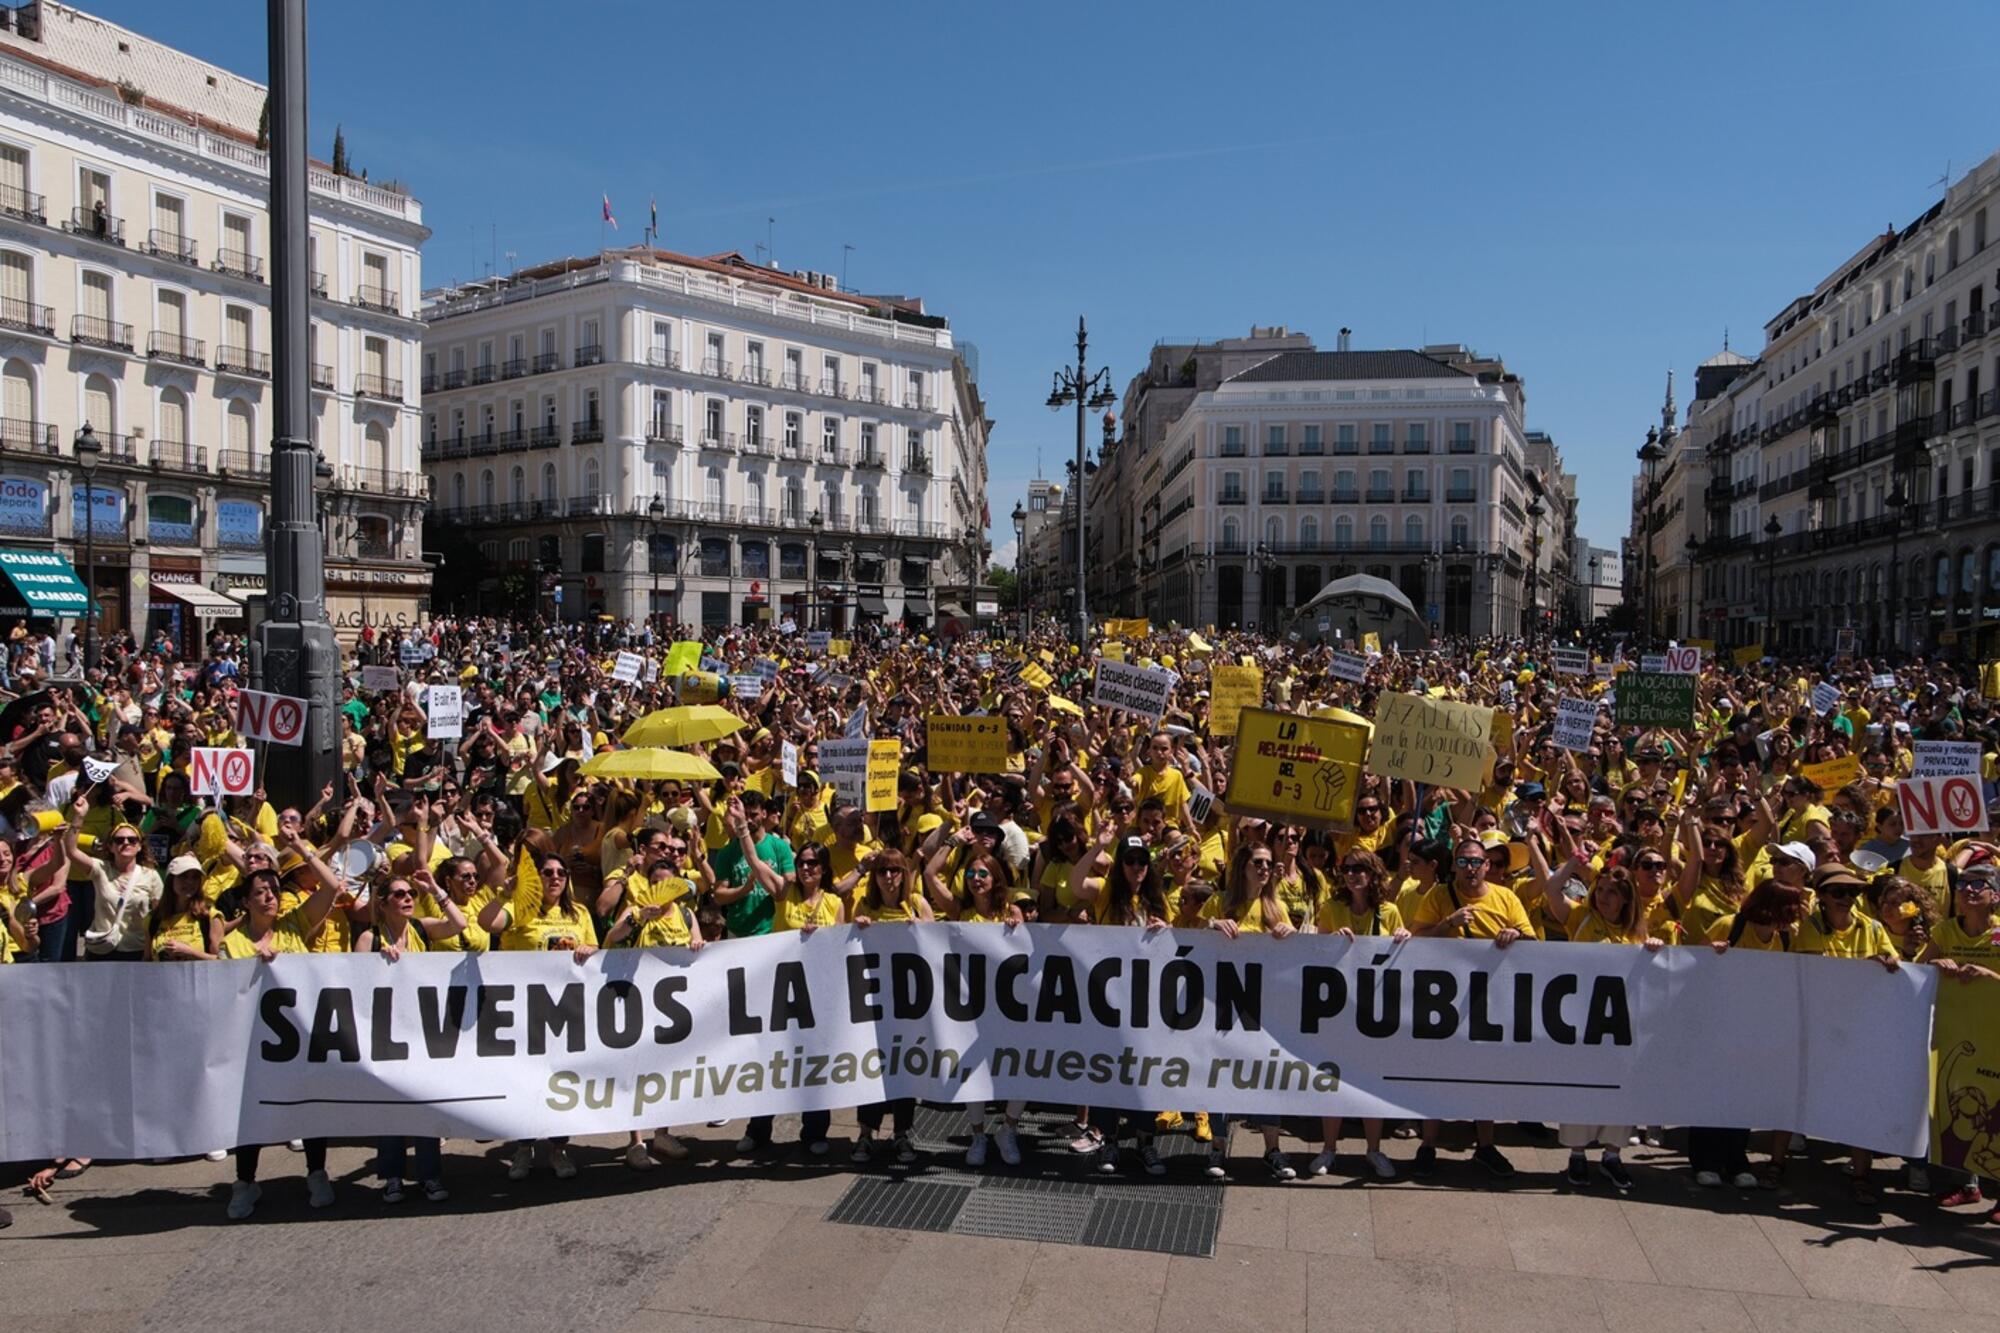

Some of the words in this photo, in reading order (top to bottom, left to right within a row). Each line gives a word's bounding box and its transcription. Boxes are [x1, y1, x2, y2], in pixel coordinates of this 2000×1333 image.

[0, 553, 62, 566] CHANGE
[12, 572, 75, 584] TRANSFER
[151, 572, 195, 583] CHANGE
[27, 590, 88, 602] CAMBIO
[1667, 649, 1697, 672] NO
[1100, 664, 1132, 688] Escuelas
[1133, 674, 1165, 696] clasistas
[1621, 675, 1636, 689] MI
[1098, 684, 1124, 704] dividen
[1626, 691, 1645, 704] NO
[1652, 691, 1681, 704] PAGA
[237, 691, 302, 741] NO
[1560, 698, 1596, 716] EDUCAR
[1617, 704, 1638, 720] MIS
[1640, 704, 1690, 721] FACTURAS
[1384, 697, 1483, 739] AZALEAS
[930, 723, 972, 733] DIGNIDAD
[977, 724, 999, 734] 0-3
[1278, 721, 1297, 740] LA
[1915, 743, 1943, 753] Escuela
[1944, 746, 1950, 755] y
[1279, 762, 1296, 778] DEL
[1387, 750, 1407, 769] del
[1422, 753, 1453, 778] 0-3
[1923, 755, 1970, 767] PRIVATIZAN
[193, 750, 251, 793] NO
[1914, 768, 1936, 778] PARA
[1272, 779, 1303, 800] 0-3
[1190, 793, 1211, 821] NO
[1900, 778, 1981, 831] NO
[260, 975, 693, 1062] SALVEMOS
[727, 960, 816, 1036] LA
[846, 946, 1263, 1032] EDUCACIÓN
[1300, 954, 1633, 1046] PÚBLICA
[545, 1070, 615, 1111] Su
[632, 1036, 970, 1117] privatización,
[991, 1045, 1190, 1088] nuestra
[1207, 1048, 1341, 1092] ruina
